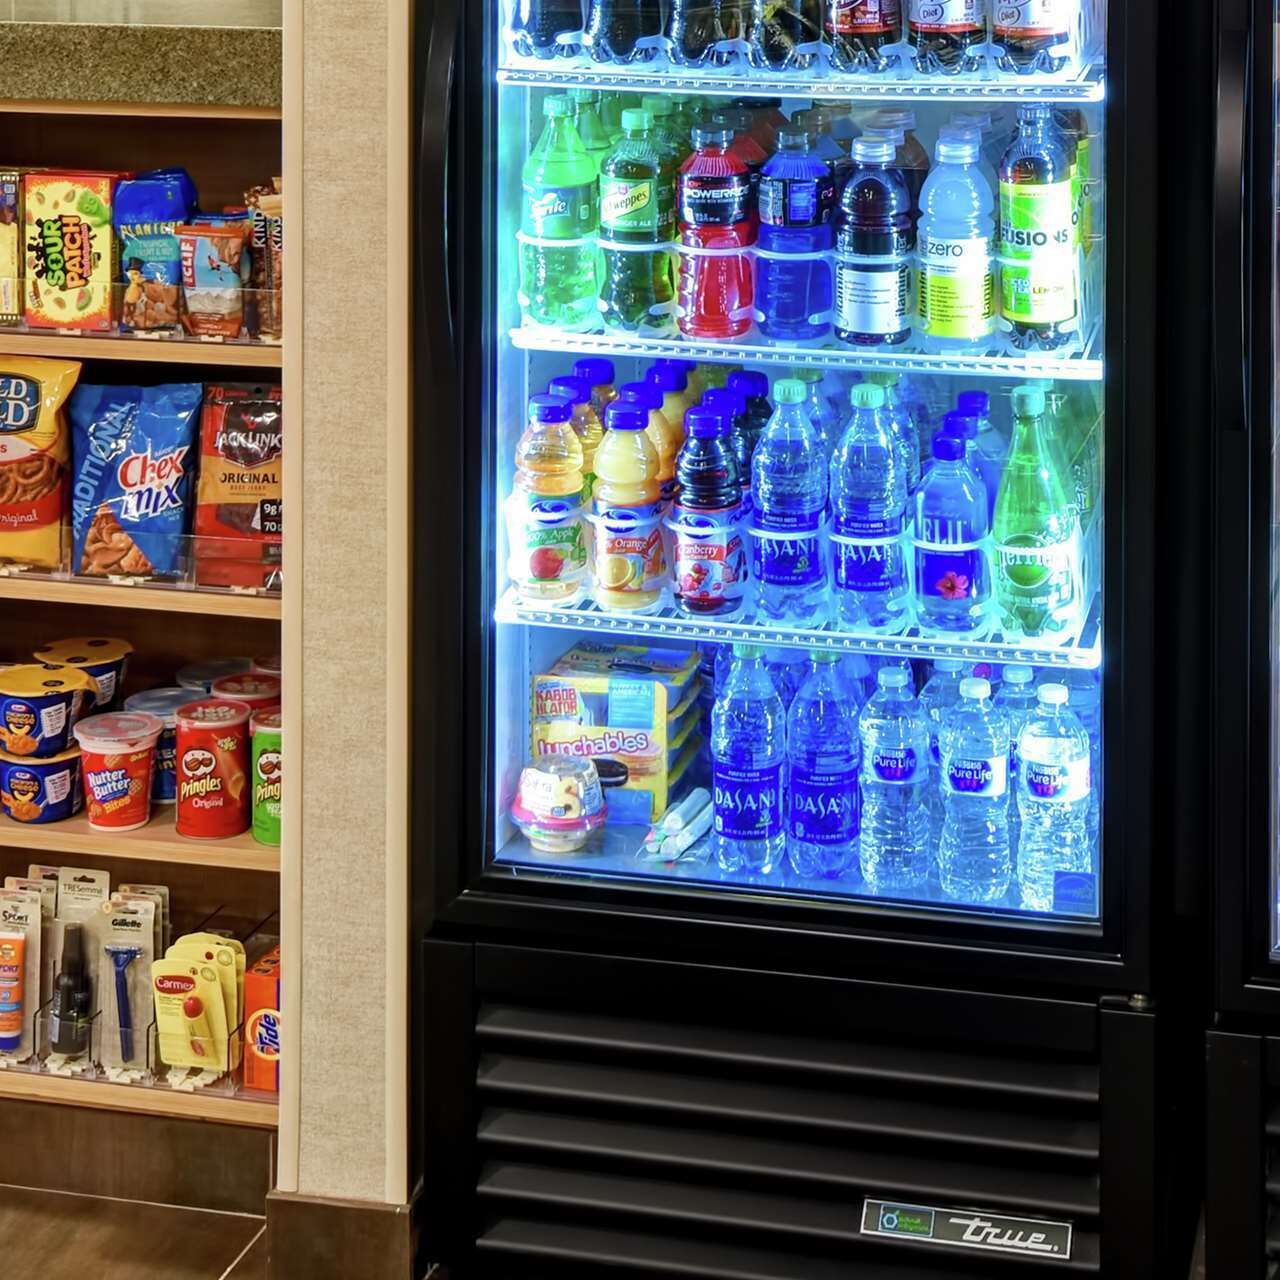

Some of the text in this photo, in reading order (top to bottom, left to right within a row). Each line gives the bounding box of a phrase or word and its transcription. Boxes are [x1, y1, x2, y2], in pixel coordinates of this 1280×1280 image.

[254, 212, 266, 247] KIND
[44, 219, 65, 287] SOUR
[63, 214, 80, 289] PATCH
[927, 242, 963, 257] zero
[207, 387, 224, 398] 70
[119, 446, 190, 489] Chex
[220, 472, 279, 484] ORIGINAL
[615, 538, 647, 550] Orange
[538, 731, 648, 756] lunchables
[872, 756, 916, 769] Pure Life
[88, 769, 126, 786] Nutter
[948, 768, 992, 783] Pure Life
[93, 778, 131, 800] Butter
[181, 775, 222, 800] Pringles
[715, 788, 775, 812] DASANI
[795, 793, 857, 819] DASANI
[112, 918, 142, 928] Gillette
[156, 978, 195, 991] Carmex
[257, 1014, 280, 1054] Tide
